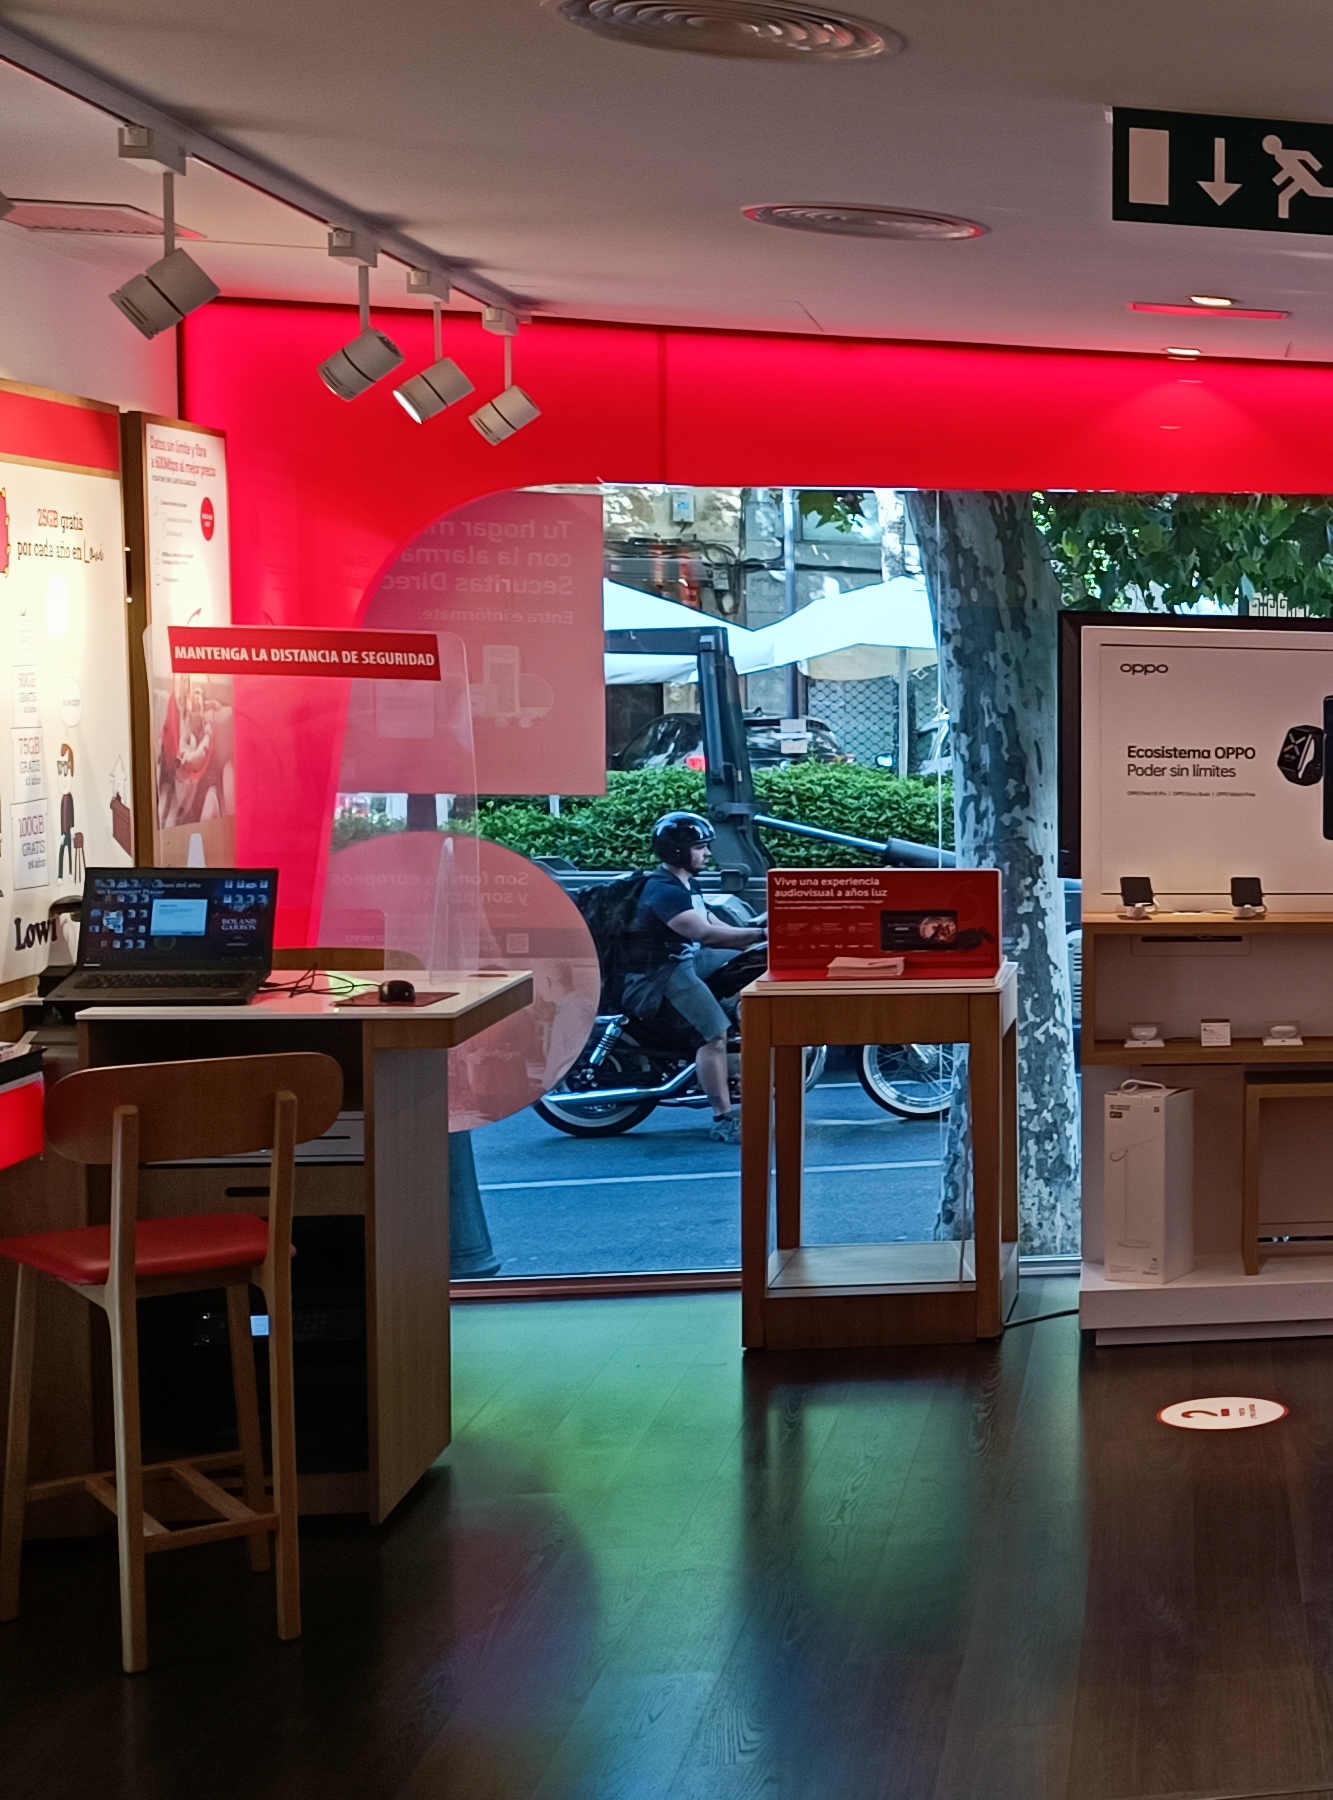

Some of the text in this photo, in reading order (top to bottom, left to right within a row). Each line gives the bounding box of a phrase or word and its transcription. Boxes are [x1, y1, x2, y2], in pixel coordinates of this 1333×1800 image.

[17, 541, 32, 560] por
[73, 546, 82, 560] en
[175, 646, 435, 666] MANTENGA LA DISTANCIA DE SEGURIDAD
[1120, 663, 1169, 675] oppo
[1127, 745, 1256, 759] Ecosistema OPPO
[1127, 764, 1167, 777] Poder
[1170, 764, 1189, 777] sin
[18, 814, 45, 837] 100GB
[774, 877, 798, 886] Vive
[821, 877, 880, 888] experiencia
[774, 889, 834, 898] audiovisual
[844, 888, 870, 897] años
[871, 888, 888, 897] luz
[14, 913, 58, 951] Lowi
